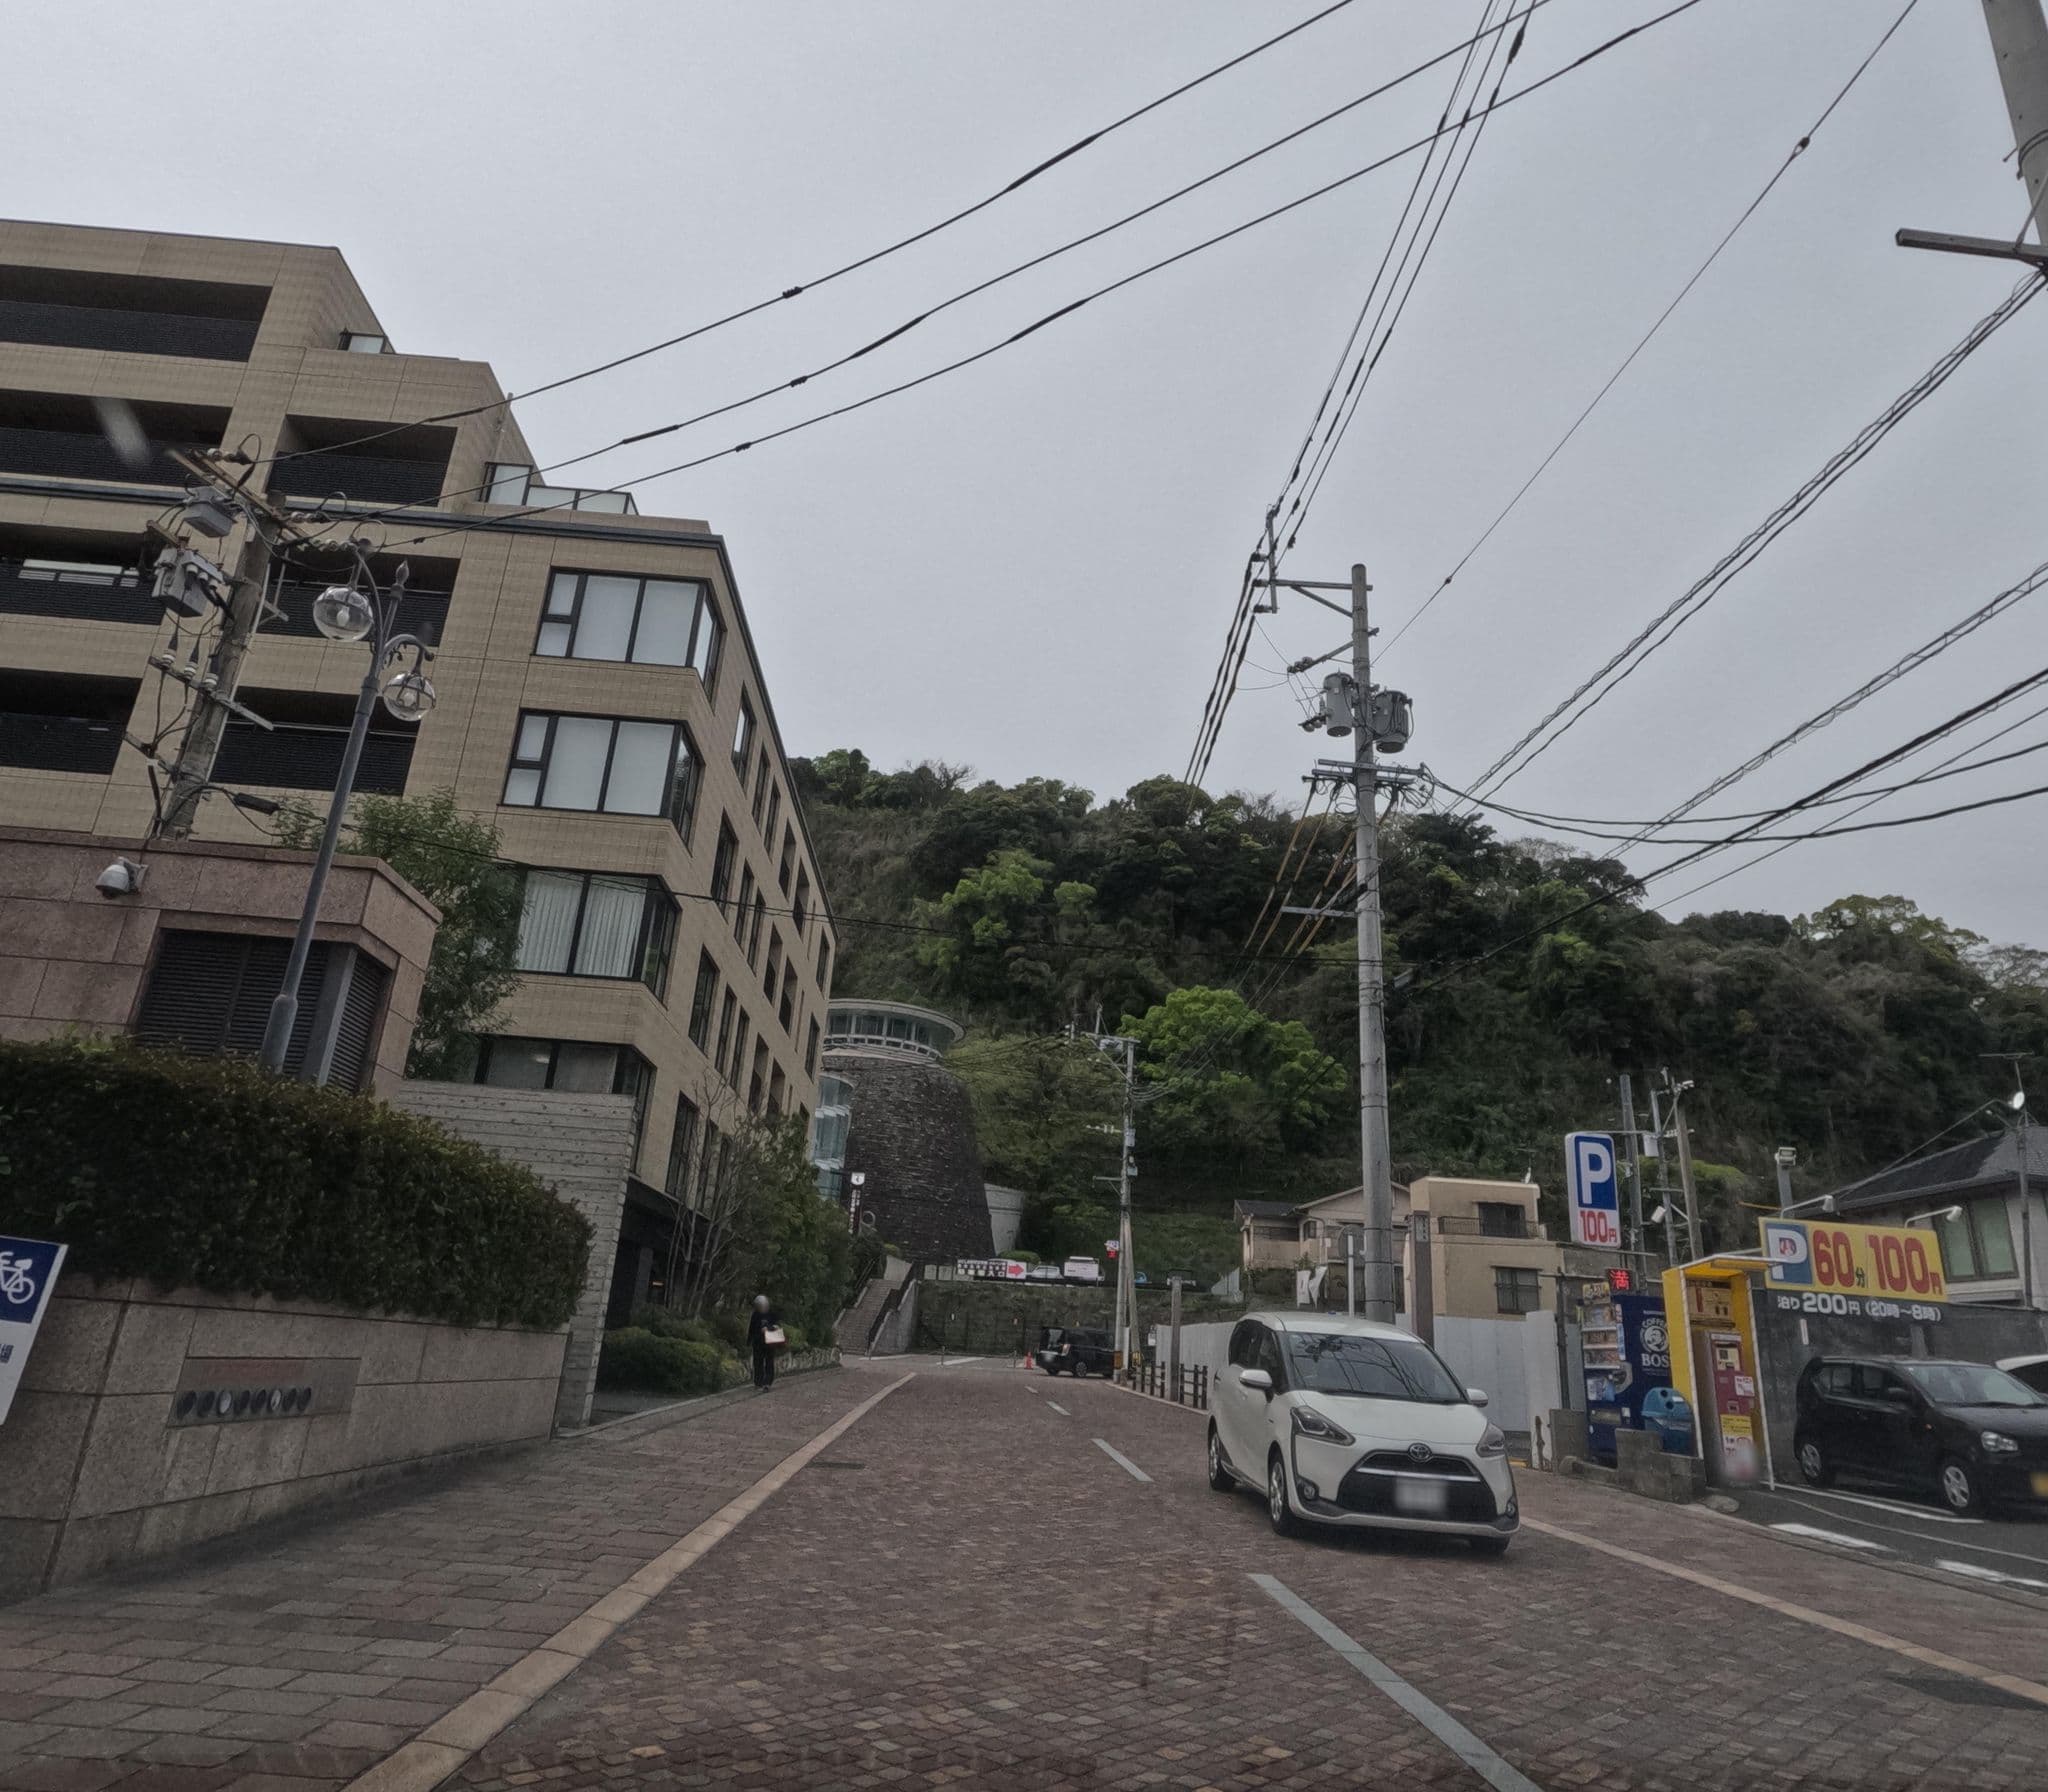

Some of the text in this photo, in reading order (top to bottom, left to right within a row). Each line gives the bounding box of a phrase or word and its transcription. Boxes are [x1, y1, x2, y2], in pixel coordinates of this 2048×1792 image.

[1579, 1141, 1612, 1204] P
[1580, 1210, 1617, 1243] 100円
[1609, 1270, 1630, 1291] 満
[1641, 1353, 1669, 1367] BOS
